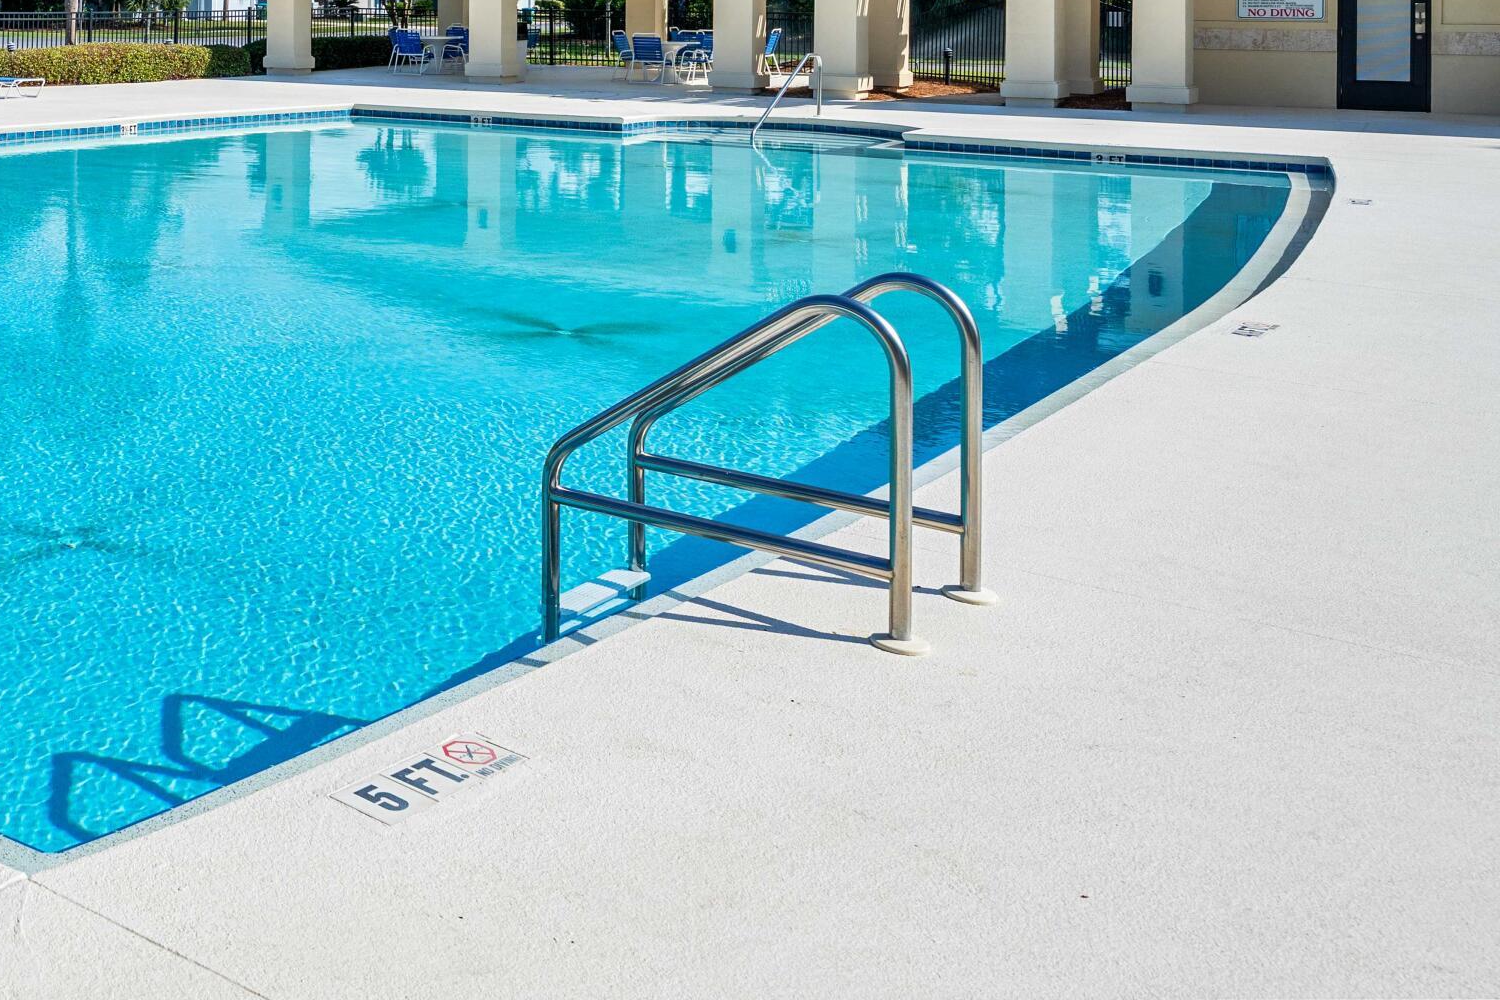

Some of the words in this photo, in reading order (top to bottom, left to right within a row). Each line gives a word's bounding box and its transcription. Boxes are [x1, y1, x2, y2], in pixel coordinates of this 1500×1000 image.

[1248, 8, 1267, 17] NO
[1270, 8, 1315, 18] DIVING
[476, 767, 495, 777] NO
[489, 754, 521, 771] DIVING
[353, 784, 410, 812] 5
[391, 758, 470, 795] FT.
